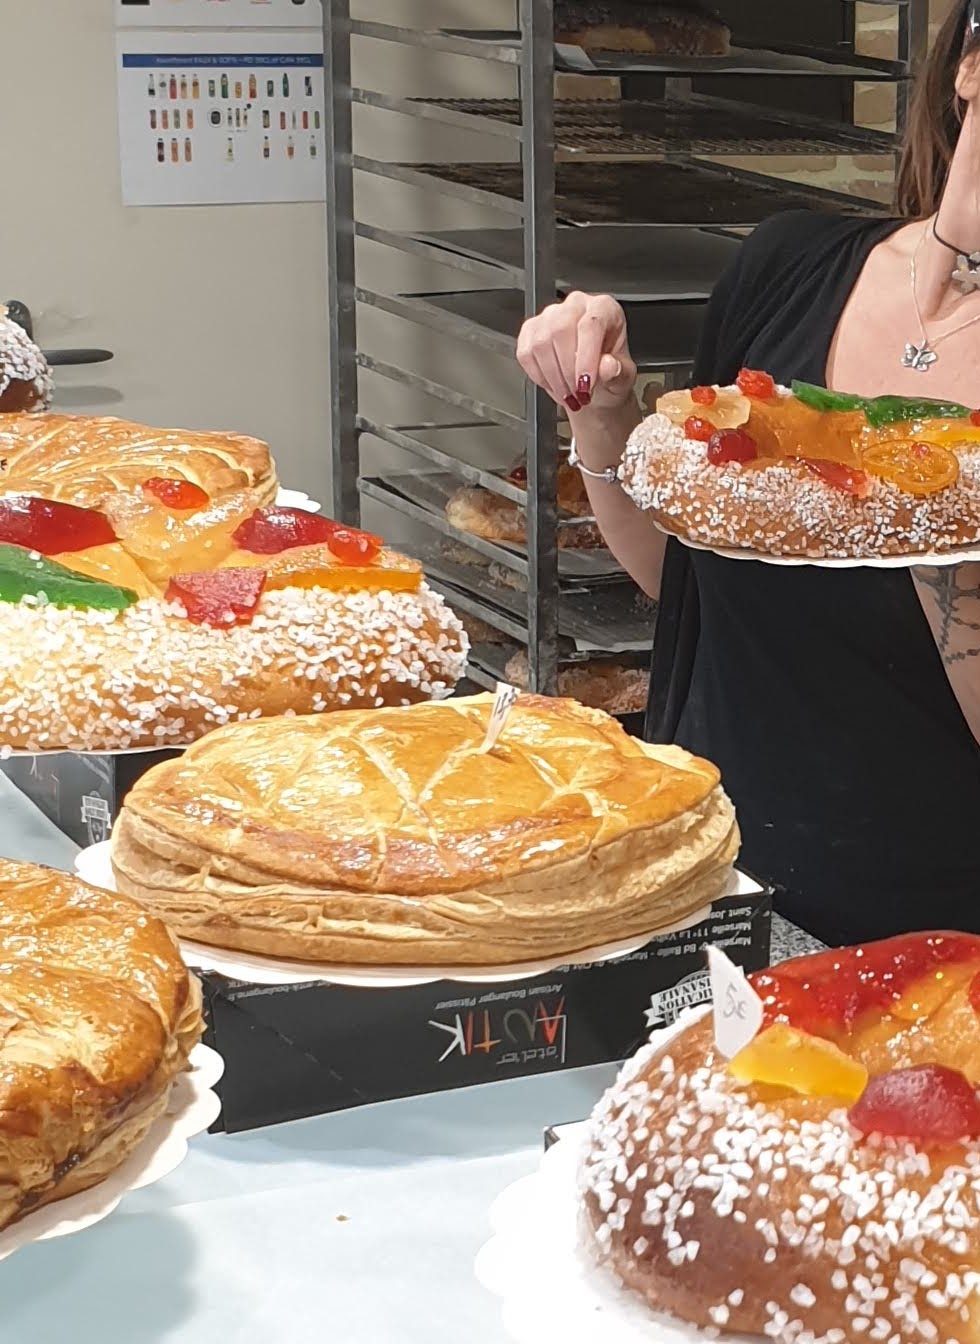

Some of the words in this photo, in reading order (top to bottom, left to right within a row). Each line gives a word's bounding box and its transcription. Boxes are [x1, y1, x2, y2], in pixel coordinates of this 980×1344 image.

[710, 910, 726, 919] Jos
[729, 906, 752, 917] Saint
[712, 922, 751, 934] Marseille
[679, 930, 691, 939] La
[712, 936, 751, 948] Marseille
[657, 946, 681, 957] Baille
[683, 943, 697, 954] Bd
[528, 984, 563, 996] Artisan
[660, 978, 712, 1003] ISANALE
[478, 989, 527, 1004] Boulanger
[658, 988, 713, 1012] ICATION
[723, 982, 748, 1020] 5€
[435, 997, 476, 1010] Pâtissier
[428, 995, 565, 1063] ANTIK
